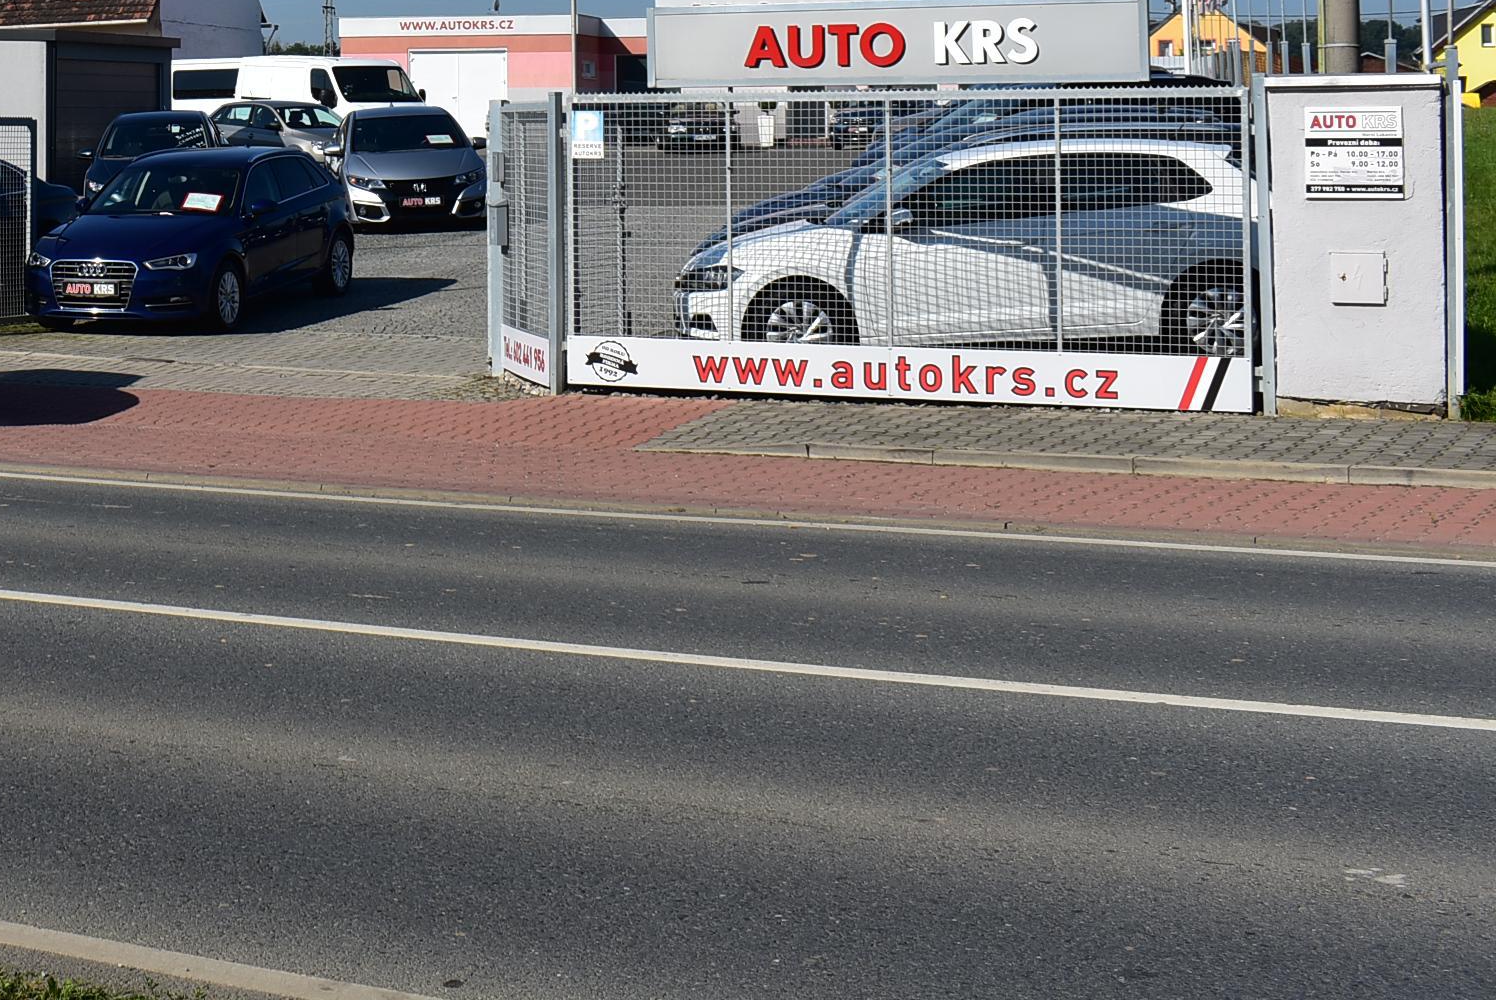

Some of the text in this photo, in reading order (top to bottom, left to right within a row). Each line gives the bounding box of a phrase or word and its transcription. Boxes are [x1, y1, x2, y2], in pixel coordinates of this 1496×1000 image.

[399, 19, 514, 31] WWW.AUTOKRS.CZ
[744, 17, 1040, 69] AUTO KRS
[577, 111, 599, 140] P
[1310, 114, 1398, 129] AUTO KRS
[1346, 150, 1368, 158] 10.00
[1376, 150, 1398, 158] 17.00
[1351, 160, 1368, 168] 9.00
[1376, 160, 1398, 168] 12.00
[403, 196, 441, 206] AUTO KRS
[66, 283, 115, 295] AUTO KRS
[522, 343, 533, 369] 441
[533, 347, 545, 373] 956
[599, 366, 618, 378] 1992
[692, 355, 1119, 400] www.autokrs.cz
